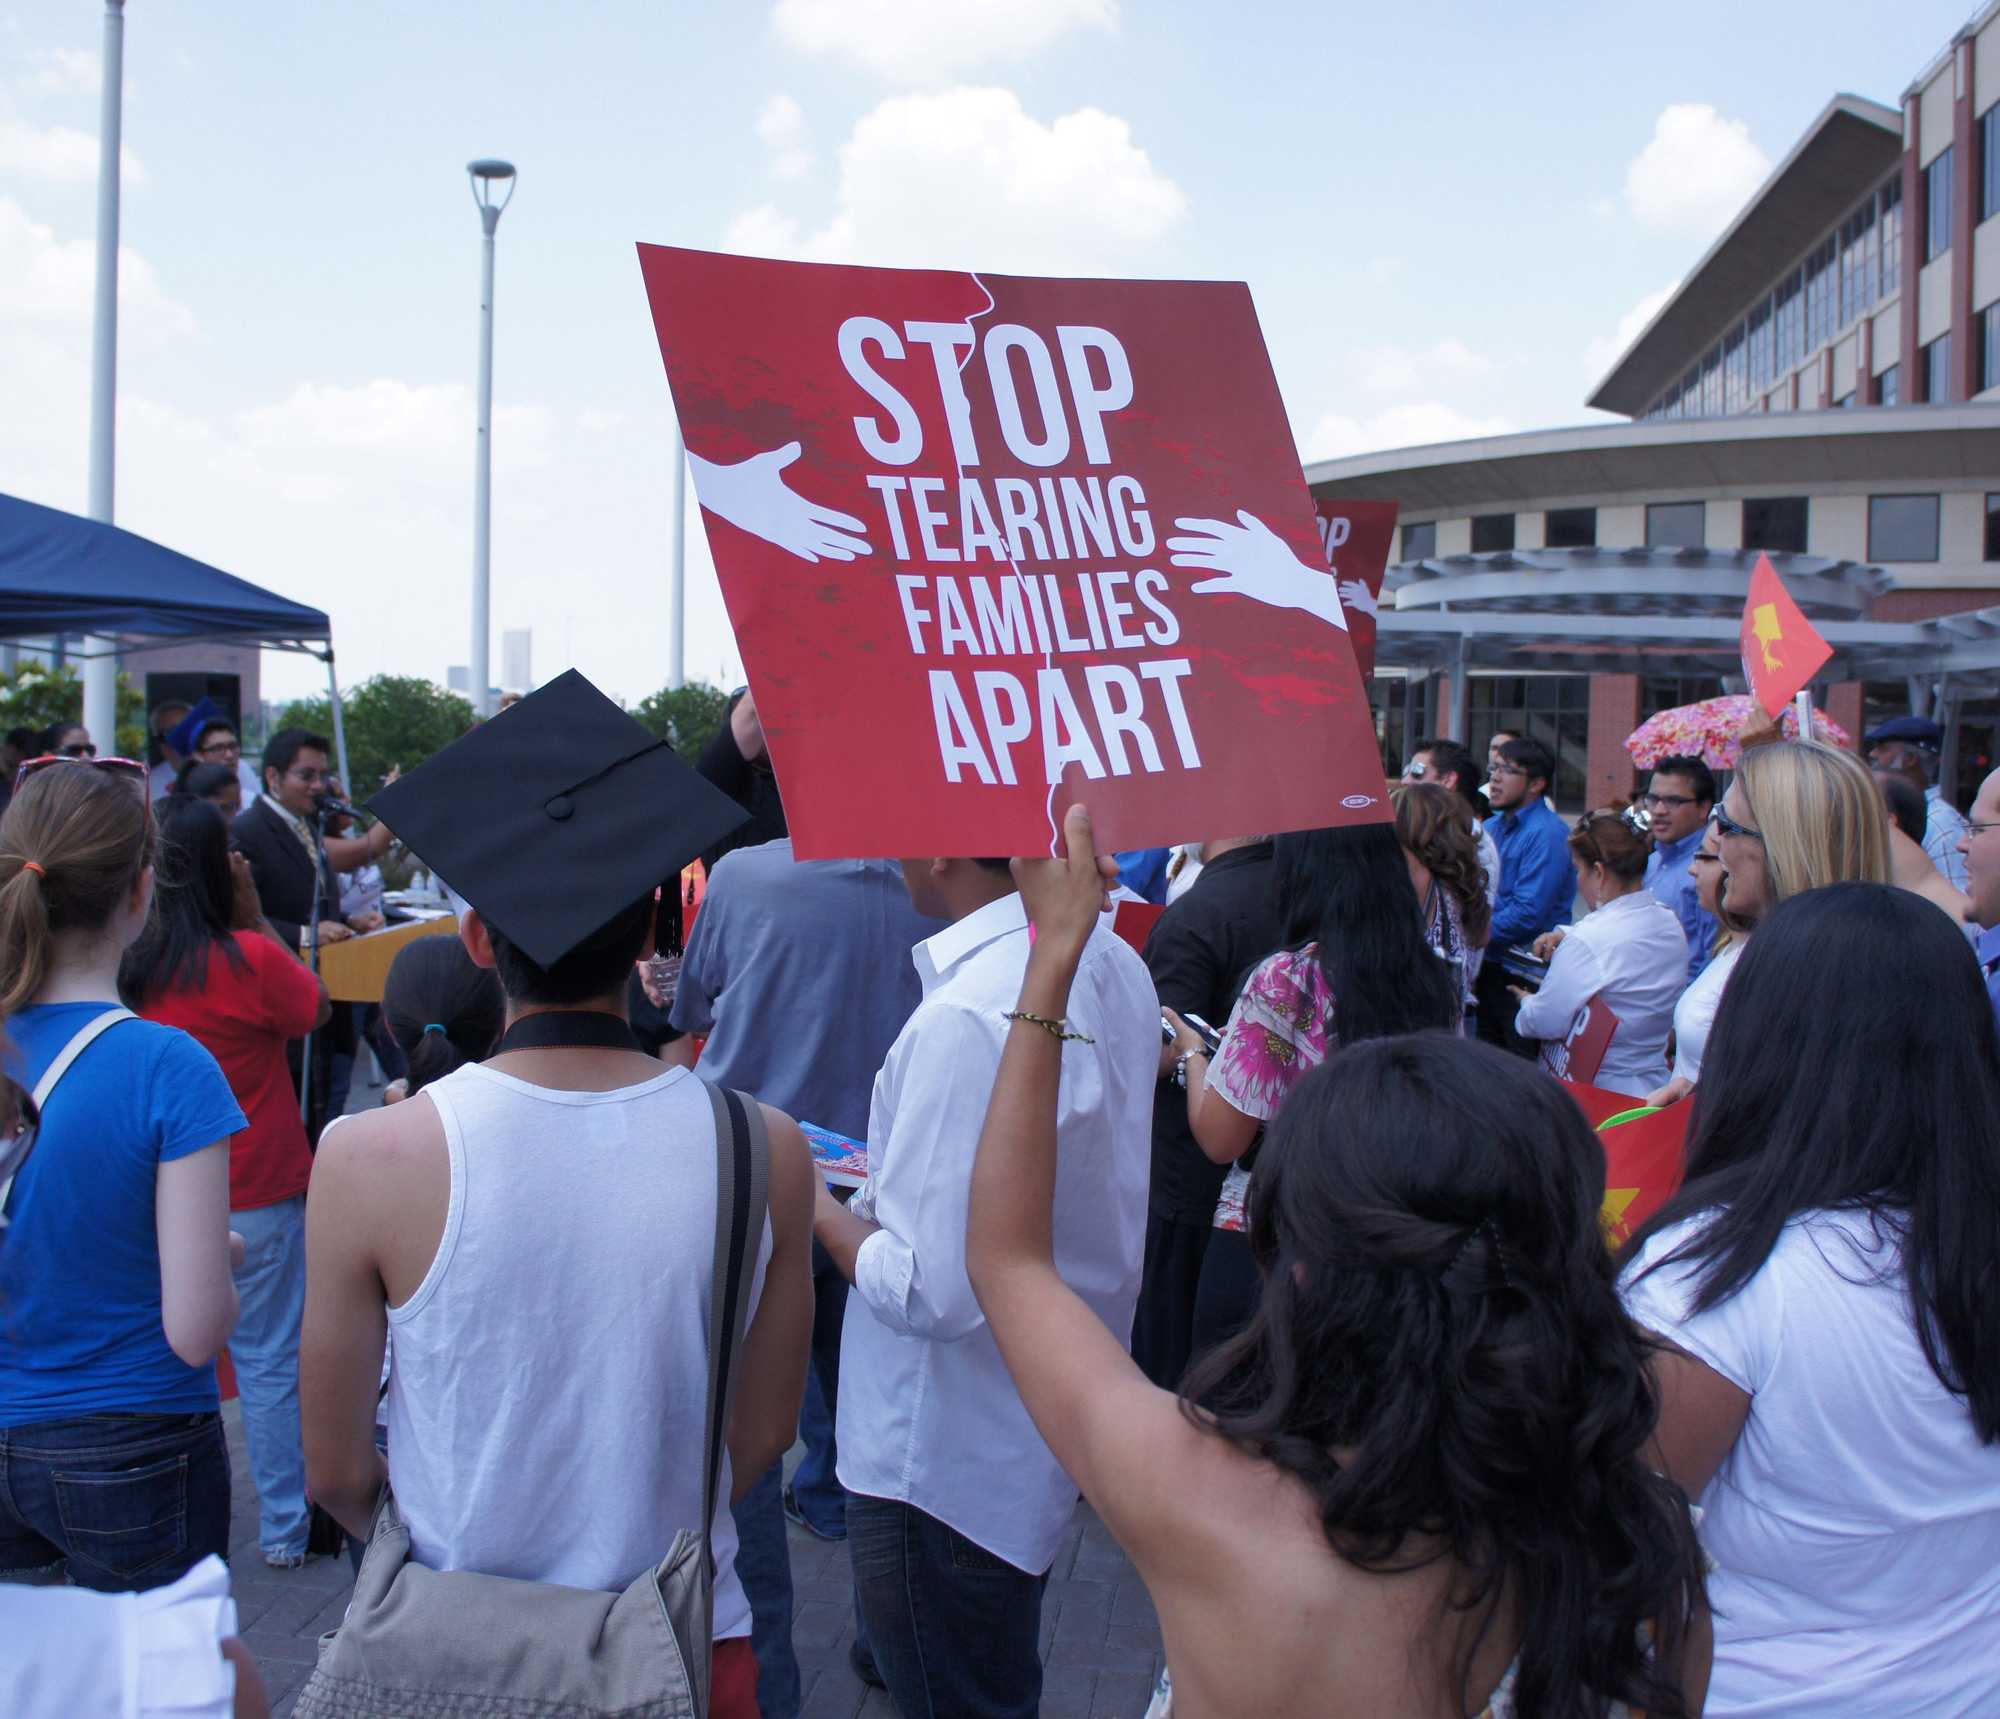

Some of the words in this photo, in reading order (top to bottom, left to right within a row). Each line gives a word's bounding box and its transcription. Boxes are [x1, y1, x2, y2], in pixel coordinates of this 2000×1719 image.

[838, 316, 1133, 467] STOP
[866, 475, 1156, 561] TEARING
[895, 569, 1180, 655] FAMILIES
[928, 658, 1202, 785] APART
